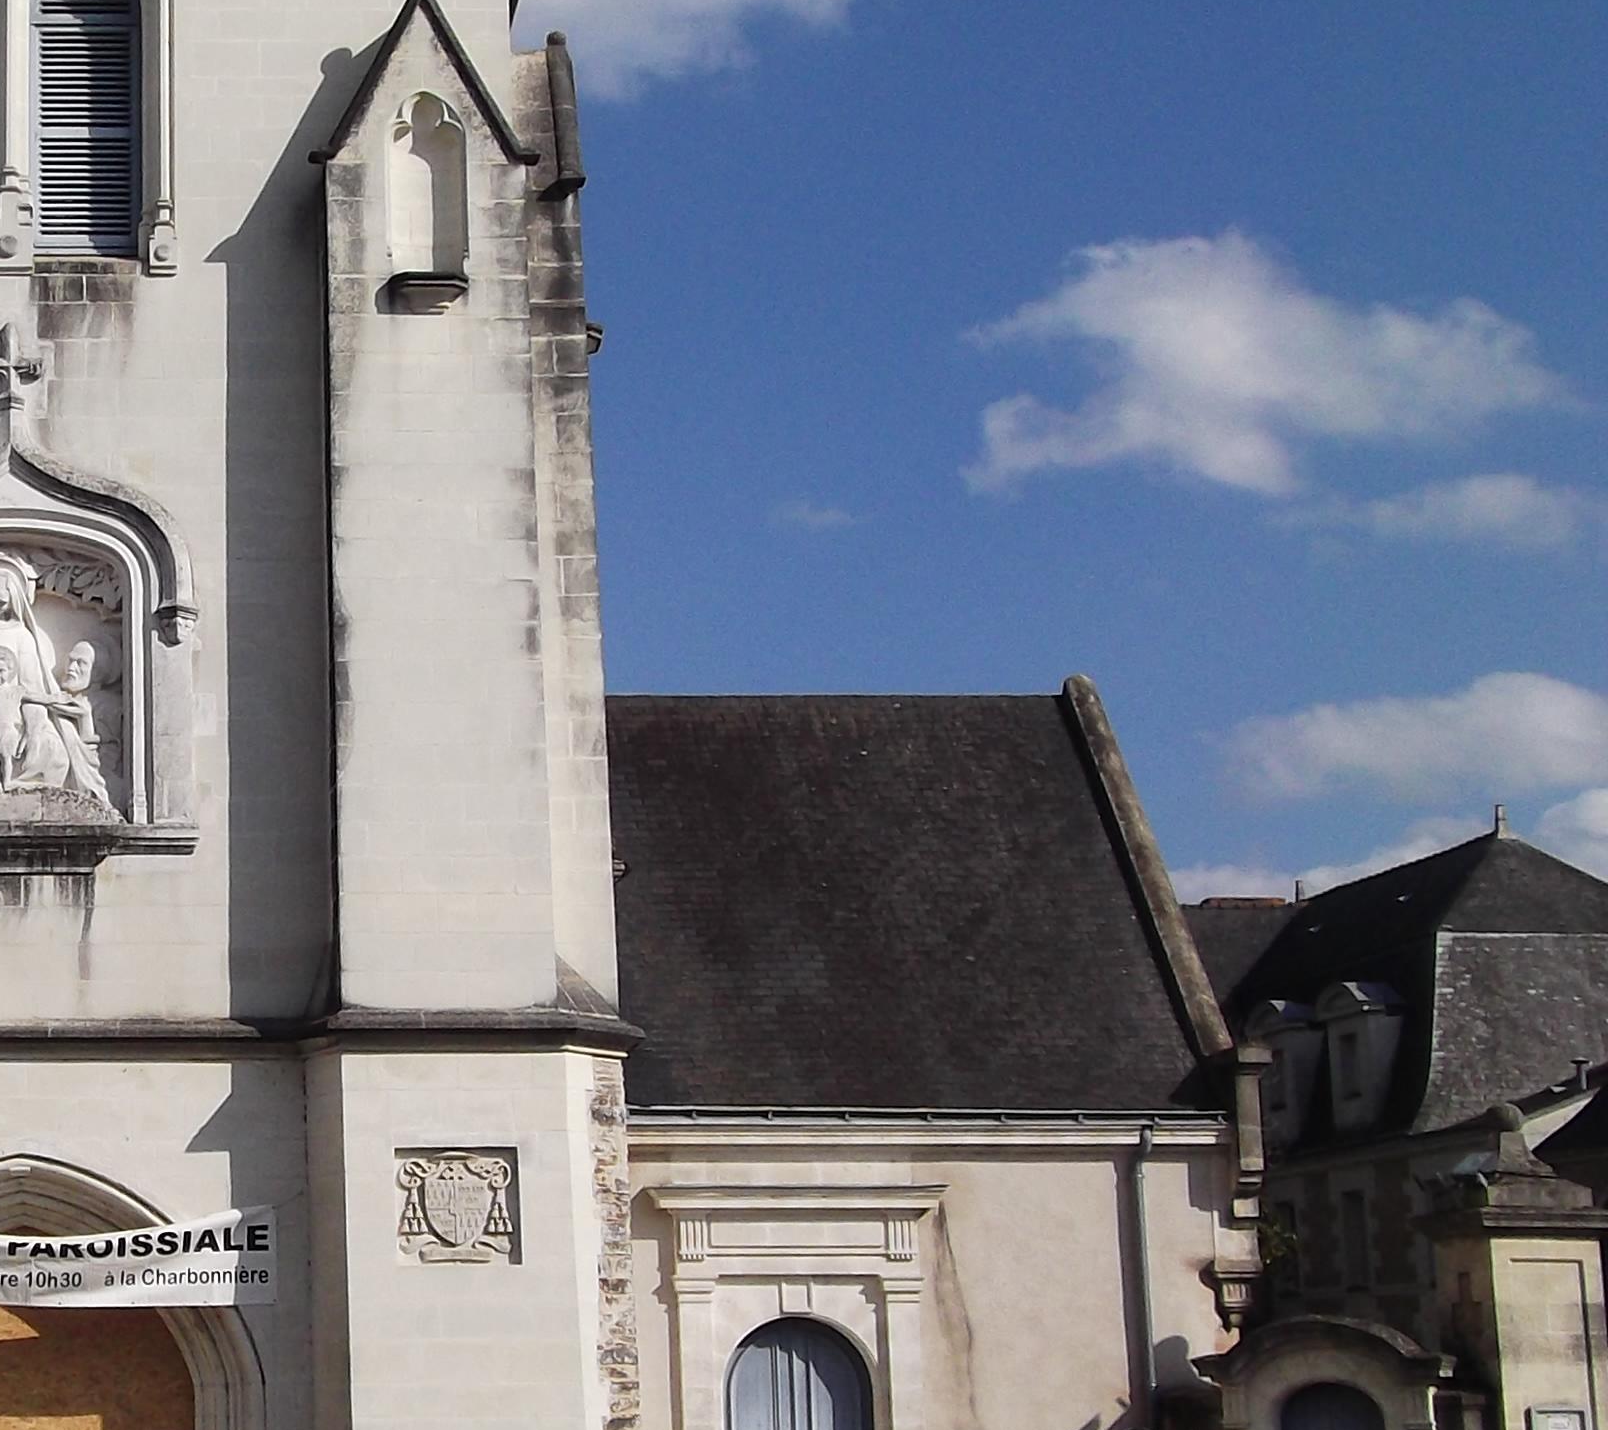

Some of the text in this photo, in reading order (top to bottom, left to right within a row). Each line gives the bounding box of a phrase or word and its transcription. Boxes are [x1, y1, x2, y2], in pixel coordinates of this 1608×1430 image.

[7, 1224, 270, 1259] PAROISSIALE
[24, 1271, 83, 1289] 10h30
[104, 1270, 114, 1287] à
[120, 1270, 136, 1287] la
[141, 1265, 269, 1286] Charbonnière
